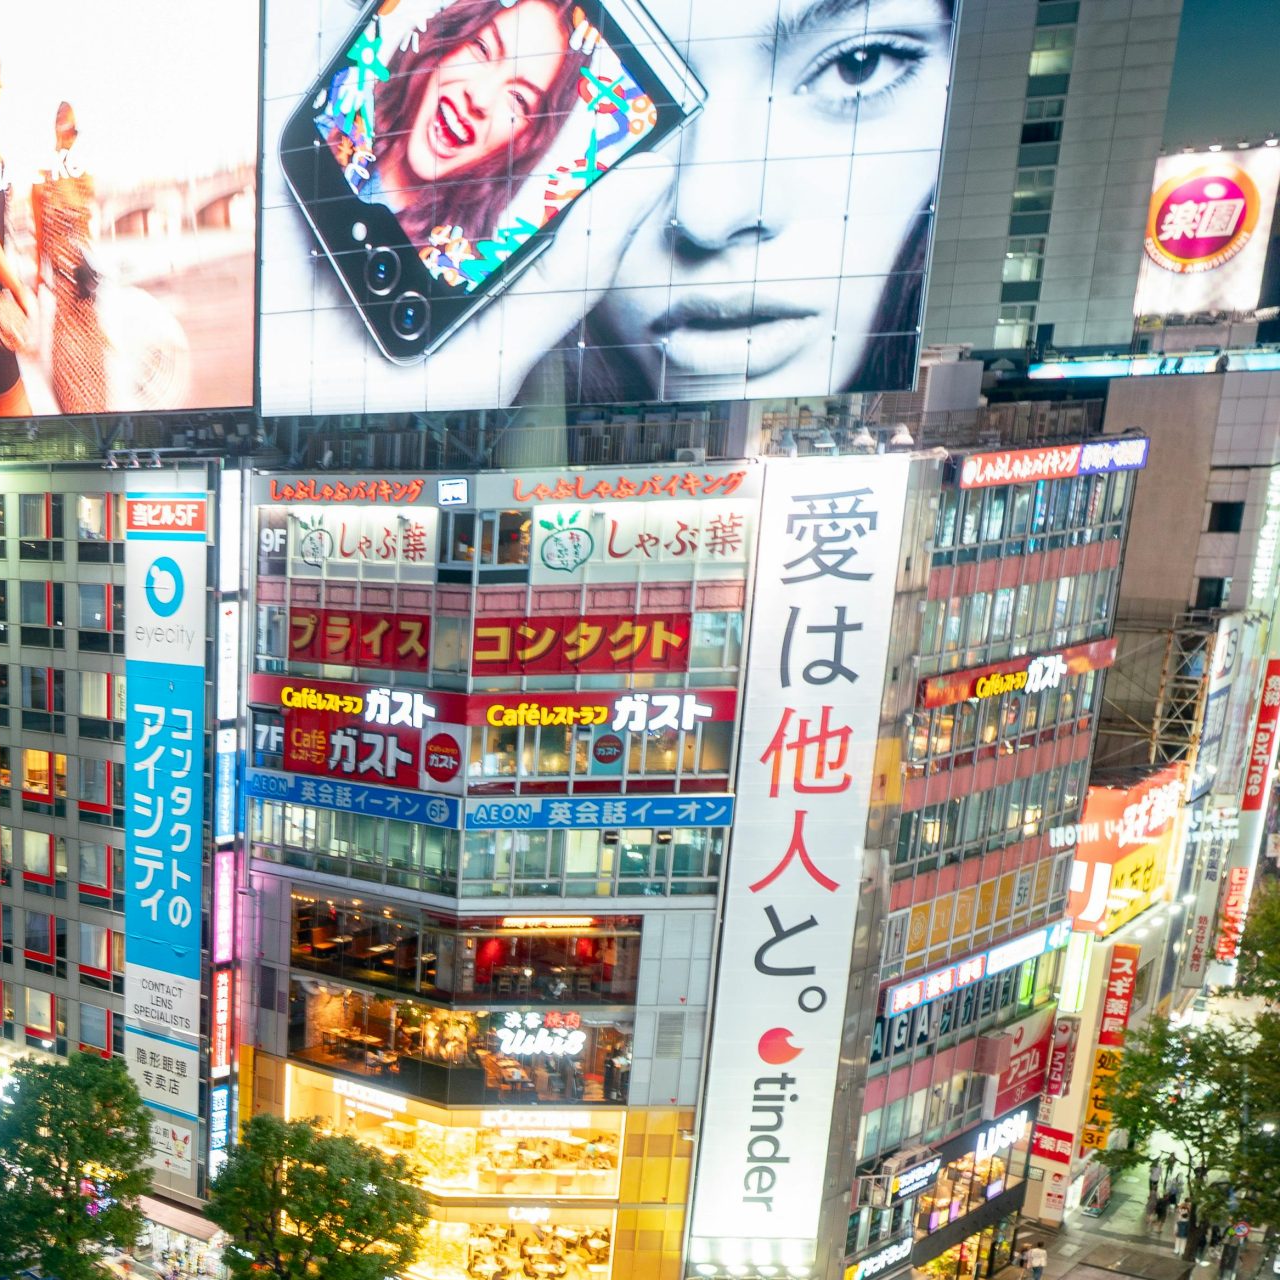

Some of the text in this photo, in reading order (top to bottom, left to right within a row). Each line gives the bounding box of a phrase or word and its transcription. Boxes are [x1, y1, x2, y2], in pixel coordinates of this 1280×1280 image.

[1159, 199, 1245, 241] 楽園
[270, 479, 426, 503] しゃぶしゃぶバイキング
[512, 470, 747, 501] しゃぶしゃぶバイキング
[132, 503, 199, 527] 当ビル5F
[260, 527, 286, 552] 9F
[338, 521, 428, 562] しゃぶ葉
[605, 513, 745, 560] しゃぶ葉
[135, 624, 197, 650] eyecity
[292, 614, 427, 658] プライス
[473, 618, 687, 664] コンタクト
[1024, 654, 1068, 694] ガスト
[280, 686, 436, 729] Caféレストラン ガスト
[486, 693, 713, 731] Caféレストラン ガスト
[254, 724, 283, 751] 7F
[291, 727, 327, 750] Café
[329, 728, 413, 779] ガスト
[748, 485, 878, 1014] 愛は他人と。
[429, 753, 460, 769] ガスト
[1246, 719, 1277, 797] TaxFree
[132, 703, 165, 922] アイシティ
[253, 776, 447, 820] AEON 英会話イーオン 6F
[473, 800, 728, 826] AEON 英会話イーオン
[169, 706, 193, 929] コンタクトの
[141, 978, 184, 1000] CONTACT
[150, 995, 174, 1011] LENS
[1102, 957, 1134, 1033] スギ薬局
[133, 1005, 191, 1030] SPECIALISTS
[505, 1011, 542, 1029] 渋谷
[136, 1047, 188, 1078] 隐形眼镜
[1007, 1047, 1041, 1086] アコム
[142, 1071, 181, 1096] 专卖店
[742, 1069, 800, 1213] tinder
[975, 1110, 1028, 1162] LUSH
[1085, 1132, 1105, 1146] 3F
